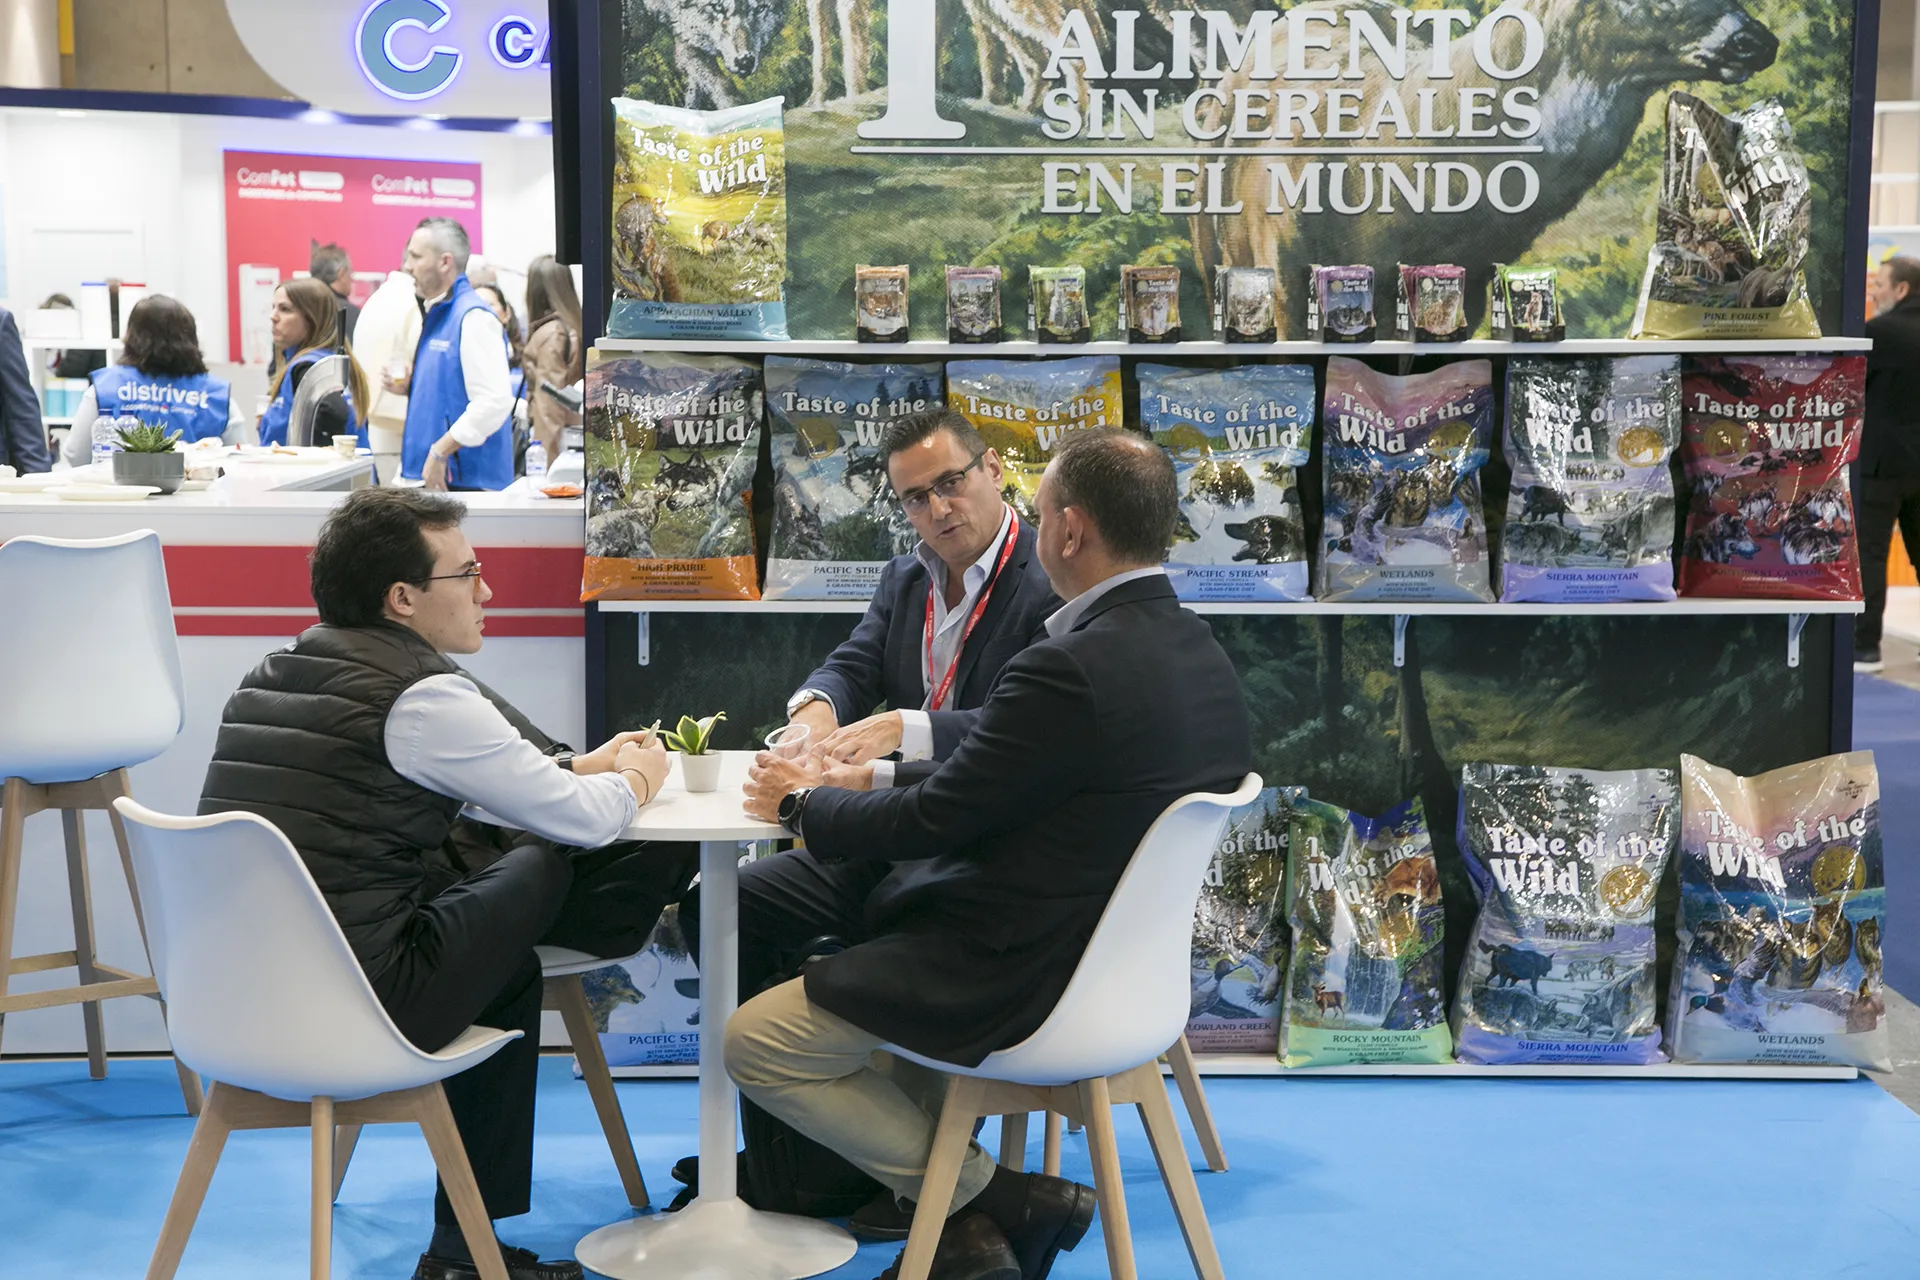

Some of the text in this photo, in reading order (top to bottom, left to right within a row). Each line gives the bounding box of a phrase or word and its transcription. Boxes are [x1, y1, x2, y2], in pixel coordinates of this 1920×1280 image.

[1041, 7, 1545, 80] ALIMENTO
[1041, 86, 1542, 140] SIN CEREALES
[630, 127, 764, 167] Taste of the
[237, 167, 296, 187] ComPet
[371, 174, 429, 194] ComPet
[697, 153, 767, 194] Wild
[1041, 160, 1540, 214] EN EL MUNDO
[717, 307, 753, 317] VALLEY
[1704, 311, 1770, 320] PINE FOREST
[117, 381, 209, 409] distrivet
[603, 383, 745, 416] Taste of the
[782, 392, 925, 417] Taste of the
[965, 394, 1105, 421] Taste of the
[1156, 393, 1297, 424] Taste of the
[1695, 392, 1845, 419] Taste of the
[1341, 392, 1476, 430] Taste of the
[1590, 399, 1616, 423] of
[1625, 398, 1666, 419] the
[673, 416, 746, 445] Wild
[1225, 422, 1299, 451] Wild
[1339, 414, 1406, 453] Wild
[1769, 420, 1843, 450] Wild
[638, 563, 706, 572] HIGH PRAIRIE
[814, 566, 882, 574] PACIFIC STRE
[1187, 569, 1268, 577] PACIFIC STREAM
[1380, 570, 1435, 578] WETLANDS
[1546, 572, 1639, 580] SIERRA MOUNTAIN
[1221, 829, 1289, 855] of the
[1487, 827, 1666, 857] Taste of the
[1776, 820, 1807, 851] of
[1817, 814, 1867, 843] the
[1354, 857, 1377, 877] of
[1383, 843, 1416, 869] the
[1308, 862, 1363, 905] Wd
[1489, 858, 1581, 896] Wild
[629, 1035, 676, 1045] PACIFIC
[1188, 1022, 1271, 1031] LOWLAND CREEK
[1333, 1034, 1422, 1043] ROCKY MOUNTAIN
[1758, 1035, 1825, 1045] WETLANDS
[1518, 1041, 1629, 1052] SIERRA MOUNTAIN
